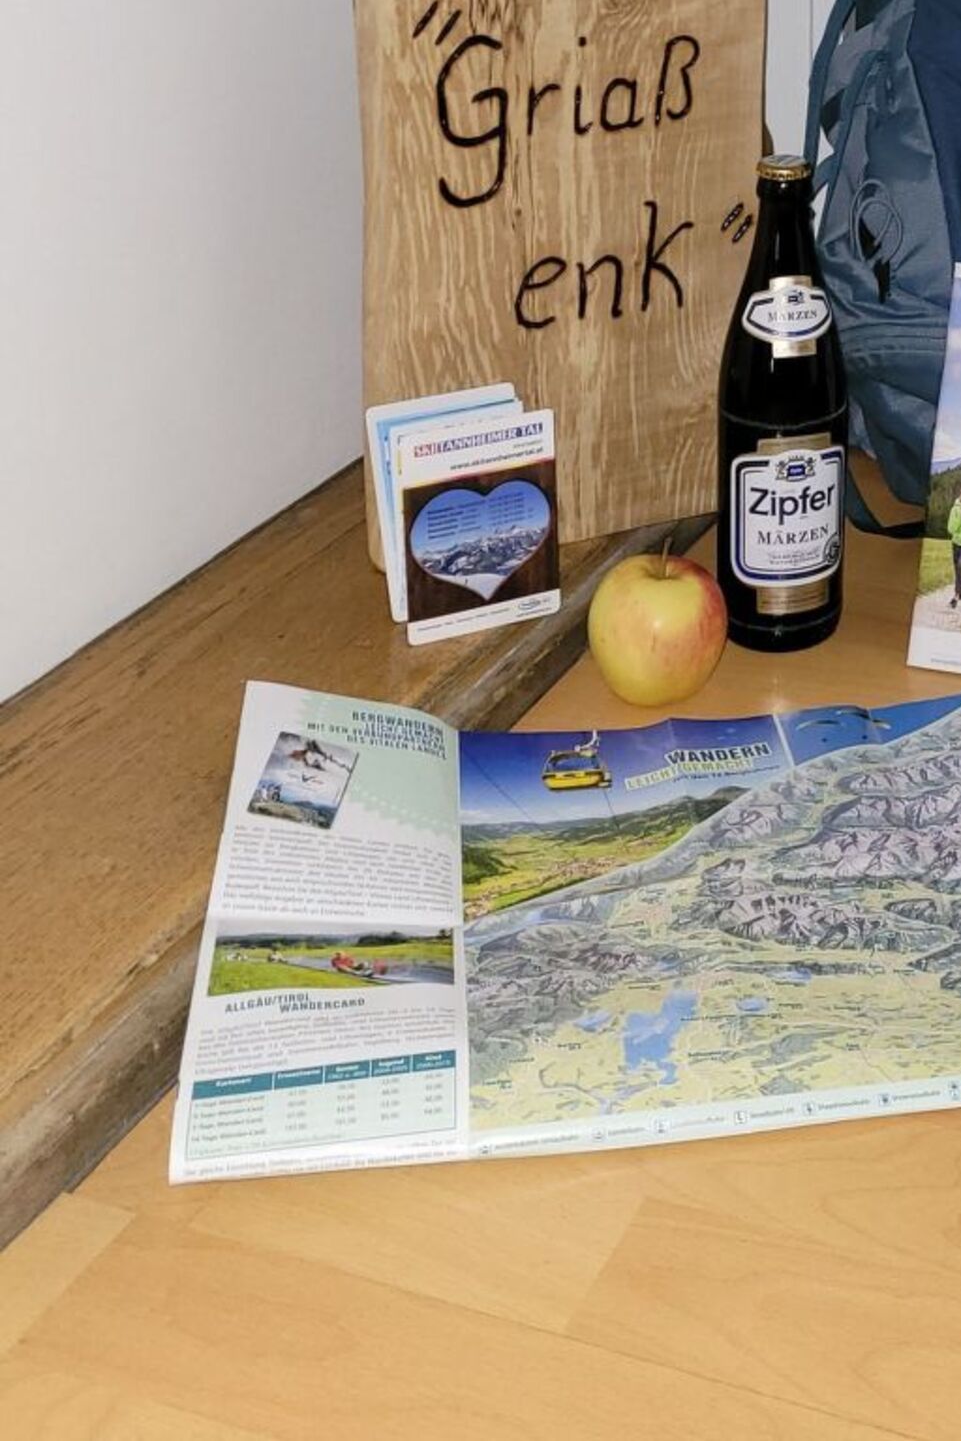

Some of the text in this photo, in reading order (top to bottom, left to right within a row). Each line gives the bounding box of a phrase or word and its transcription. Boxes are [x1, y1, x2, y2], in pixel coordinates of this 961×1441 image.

[749, 483, 836, 526] Zipfer
[757, 523, 830, 546] MÄRZEN
[668, 742, 771, 765] WANDERN
